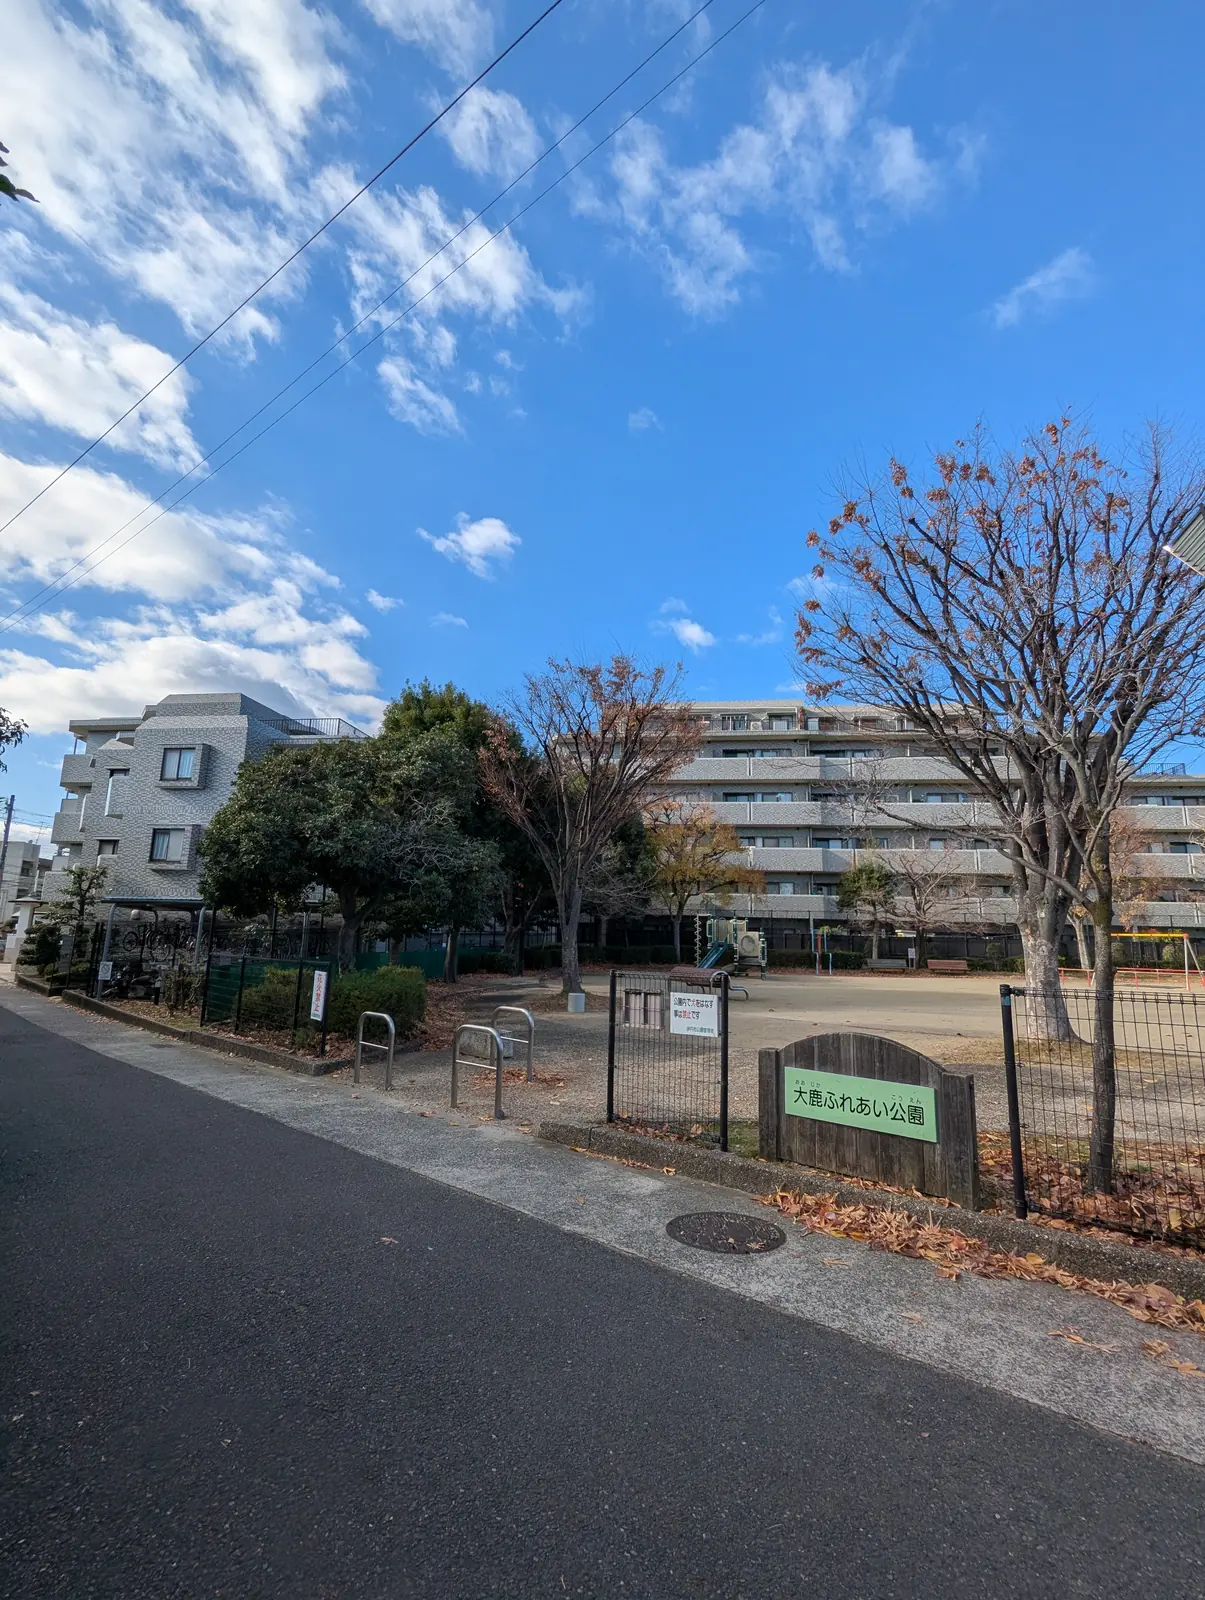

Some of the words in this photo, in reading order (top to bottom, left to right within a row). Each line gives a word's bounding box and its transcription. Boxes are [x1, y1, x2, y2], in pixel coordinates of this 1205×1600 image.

[673, 997, 714, 1009] 公園内で犬をはなす
[674, 1010, 701, 1020] 事は禁止です
[793, 1086, 924, 1126] 大鹿ふれあい公園
